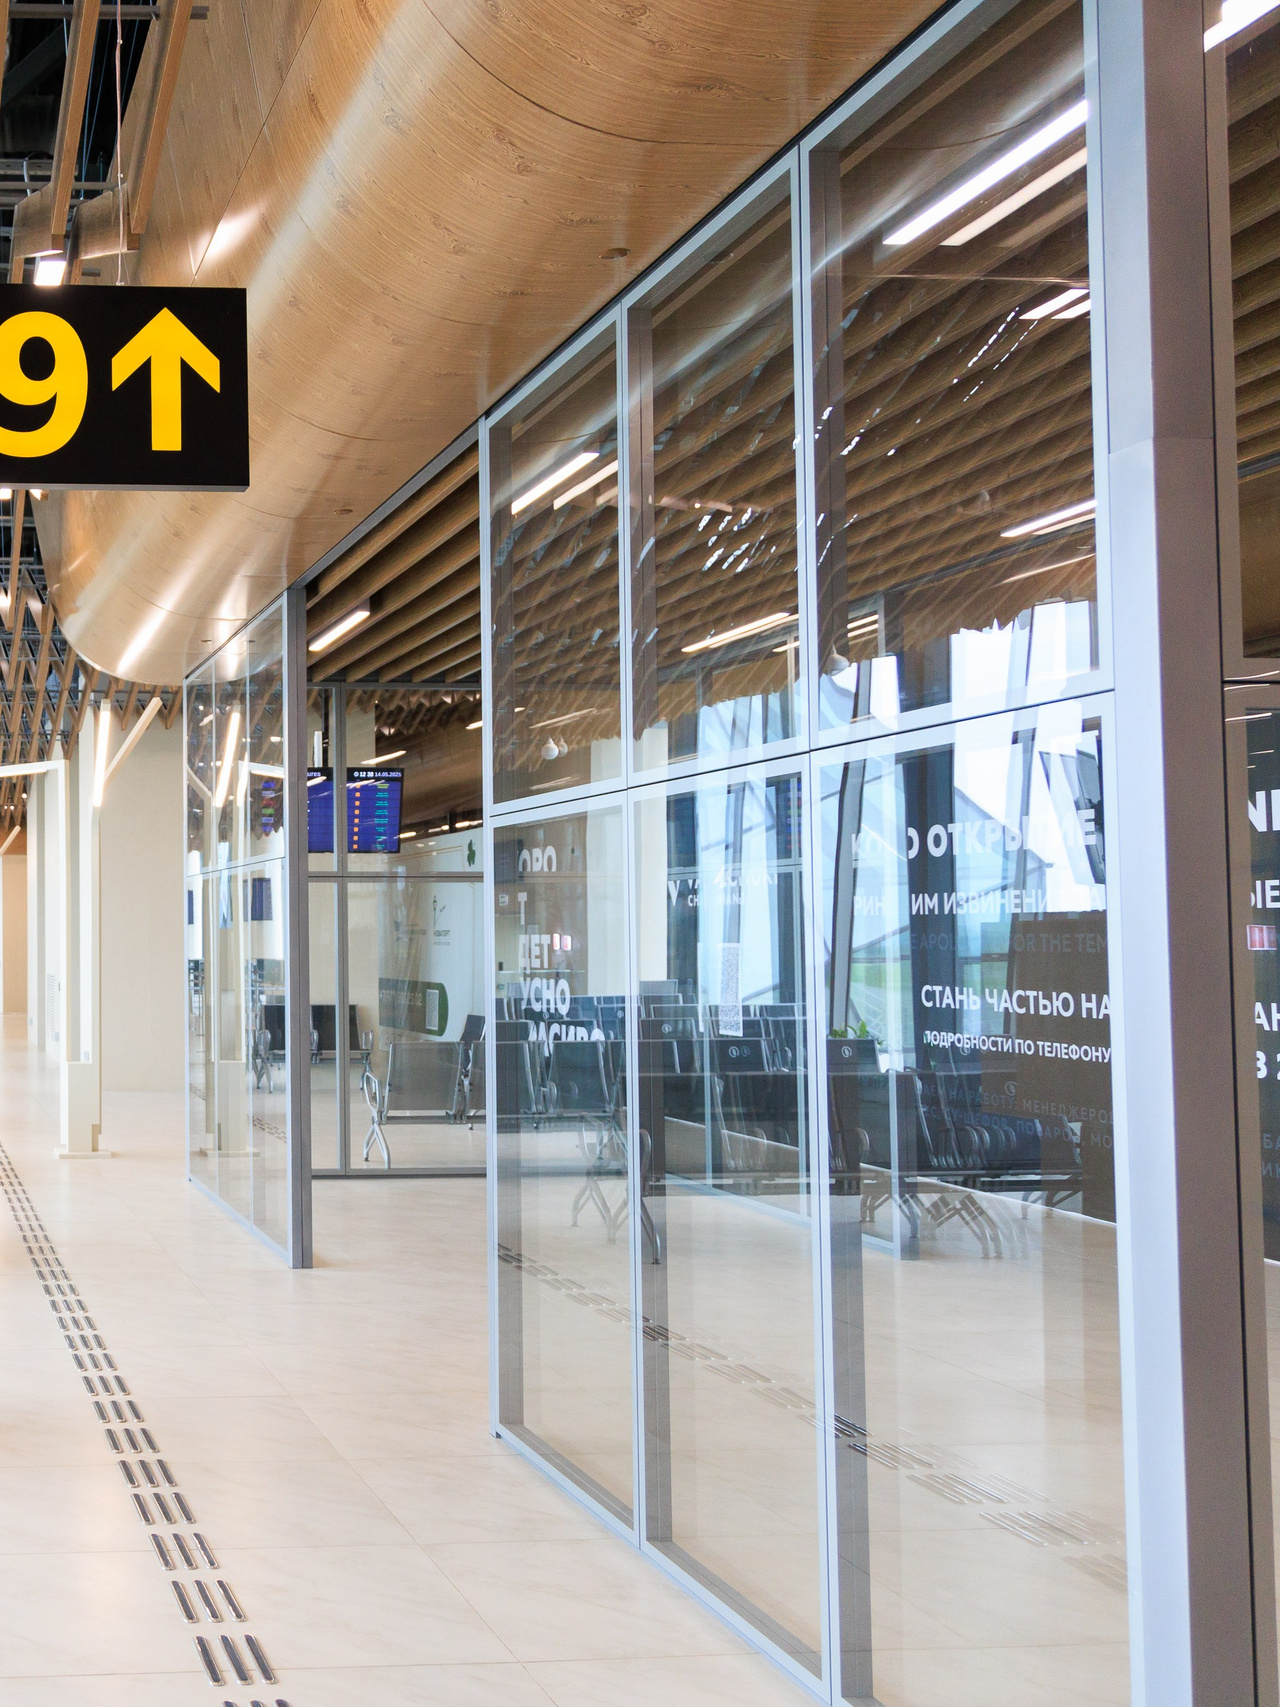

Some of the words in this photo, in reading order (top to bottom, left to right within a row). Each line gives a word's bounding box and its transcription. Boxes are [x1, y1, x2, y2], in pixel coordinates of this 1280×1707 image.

[943, 887, 1064, 916] ИЗВИНЕНИ
[921, 985, 980, 1010] СТАНЬ
[985, 988, 1074, 1017] ЧАСТЬЮ
[924, 1031, 1012, 1053] ПОДРОБНОСТИ
[1015, 1039, 1034, 1055] ПО
[1037, 1041, 1110, 1063] ТЕЛЕФОНУ
[1023, 1098, 1111, 1124] МЕНЕДЖЕРО
